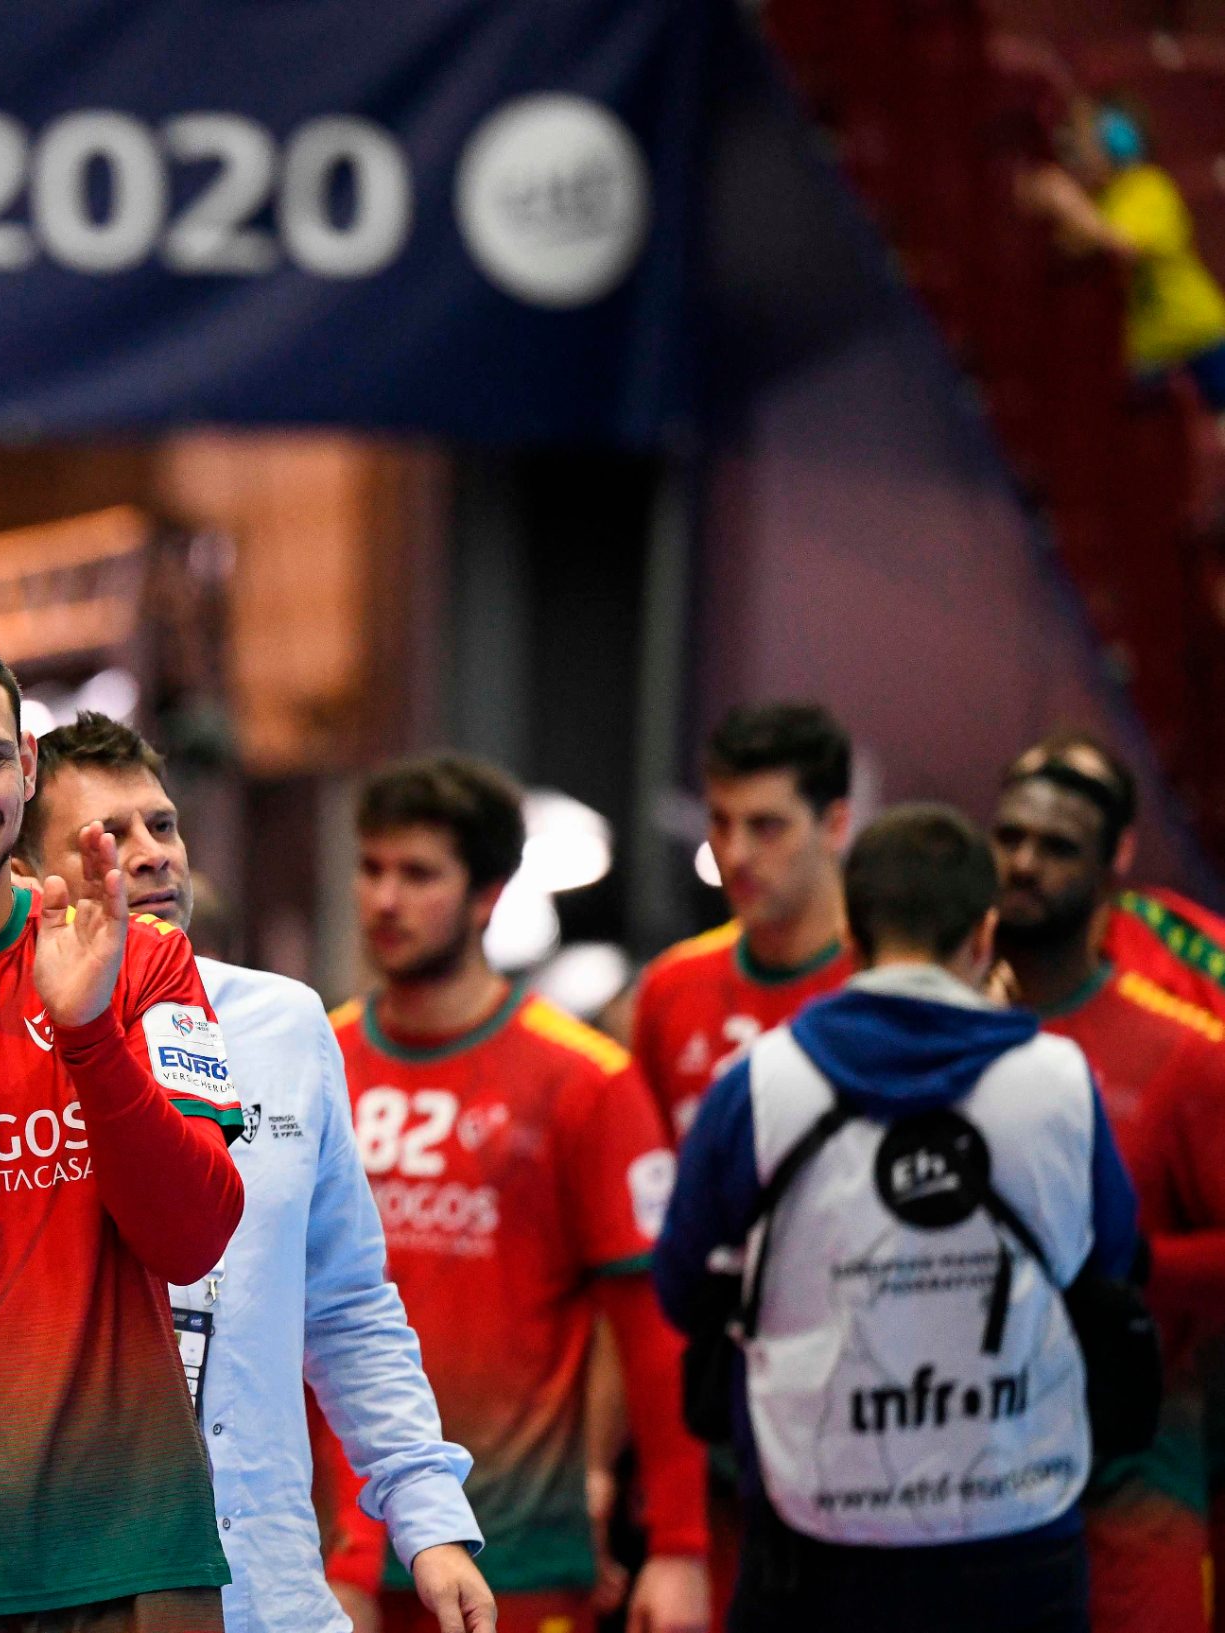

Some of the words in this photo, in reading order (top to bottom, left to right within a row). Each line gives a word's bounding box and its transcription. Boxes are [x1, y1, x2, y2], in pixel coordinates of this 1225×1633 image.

[158, 1046, 229, 1081] EURO
[355, 1085, 460, 1177] 82
[374, 1179, 499, 1234] OGOS
